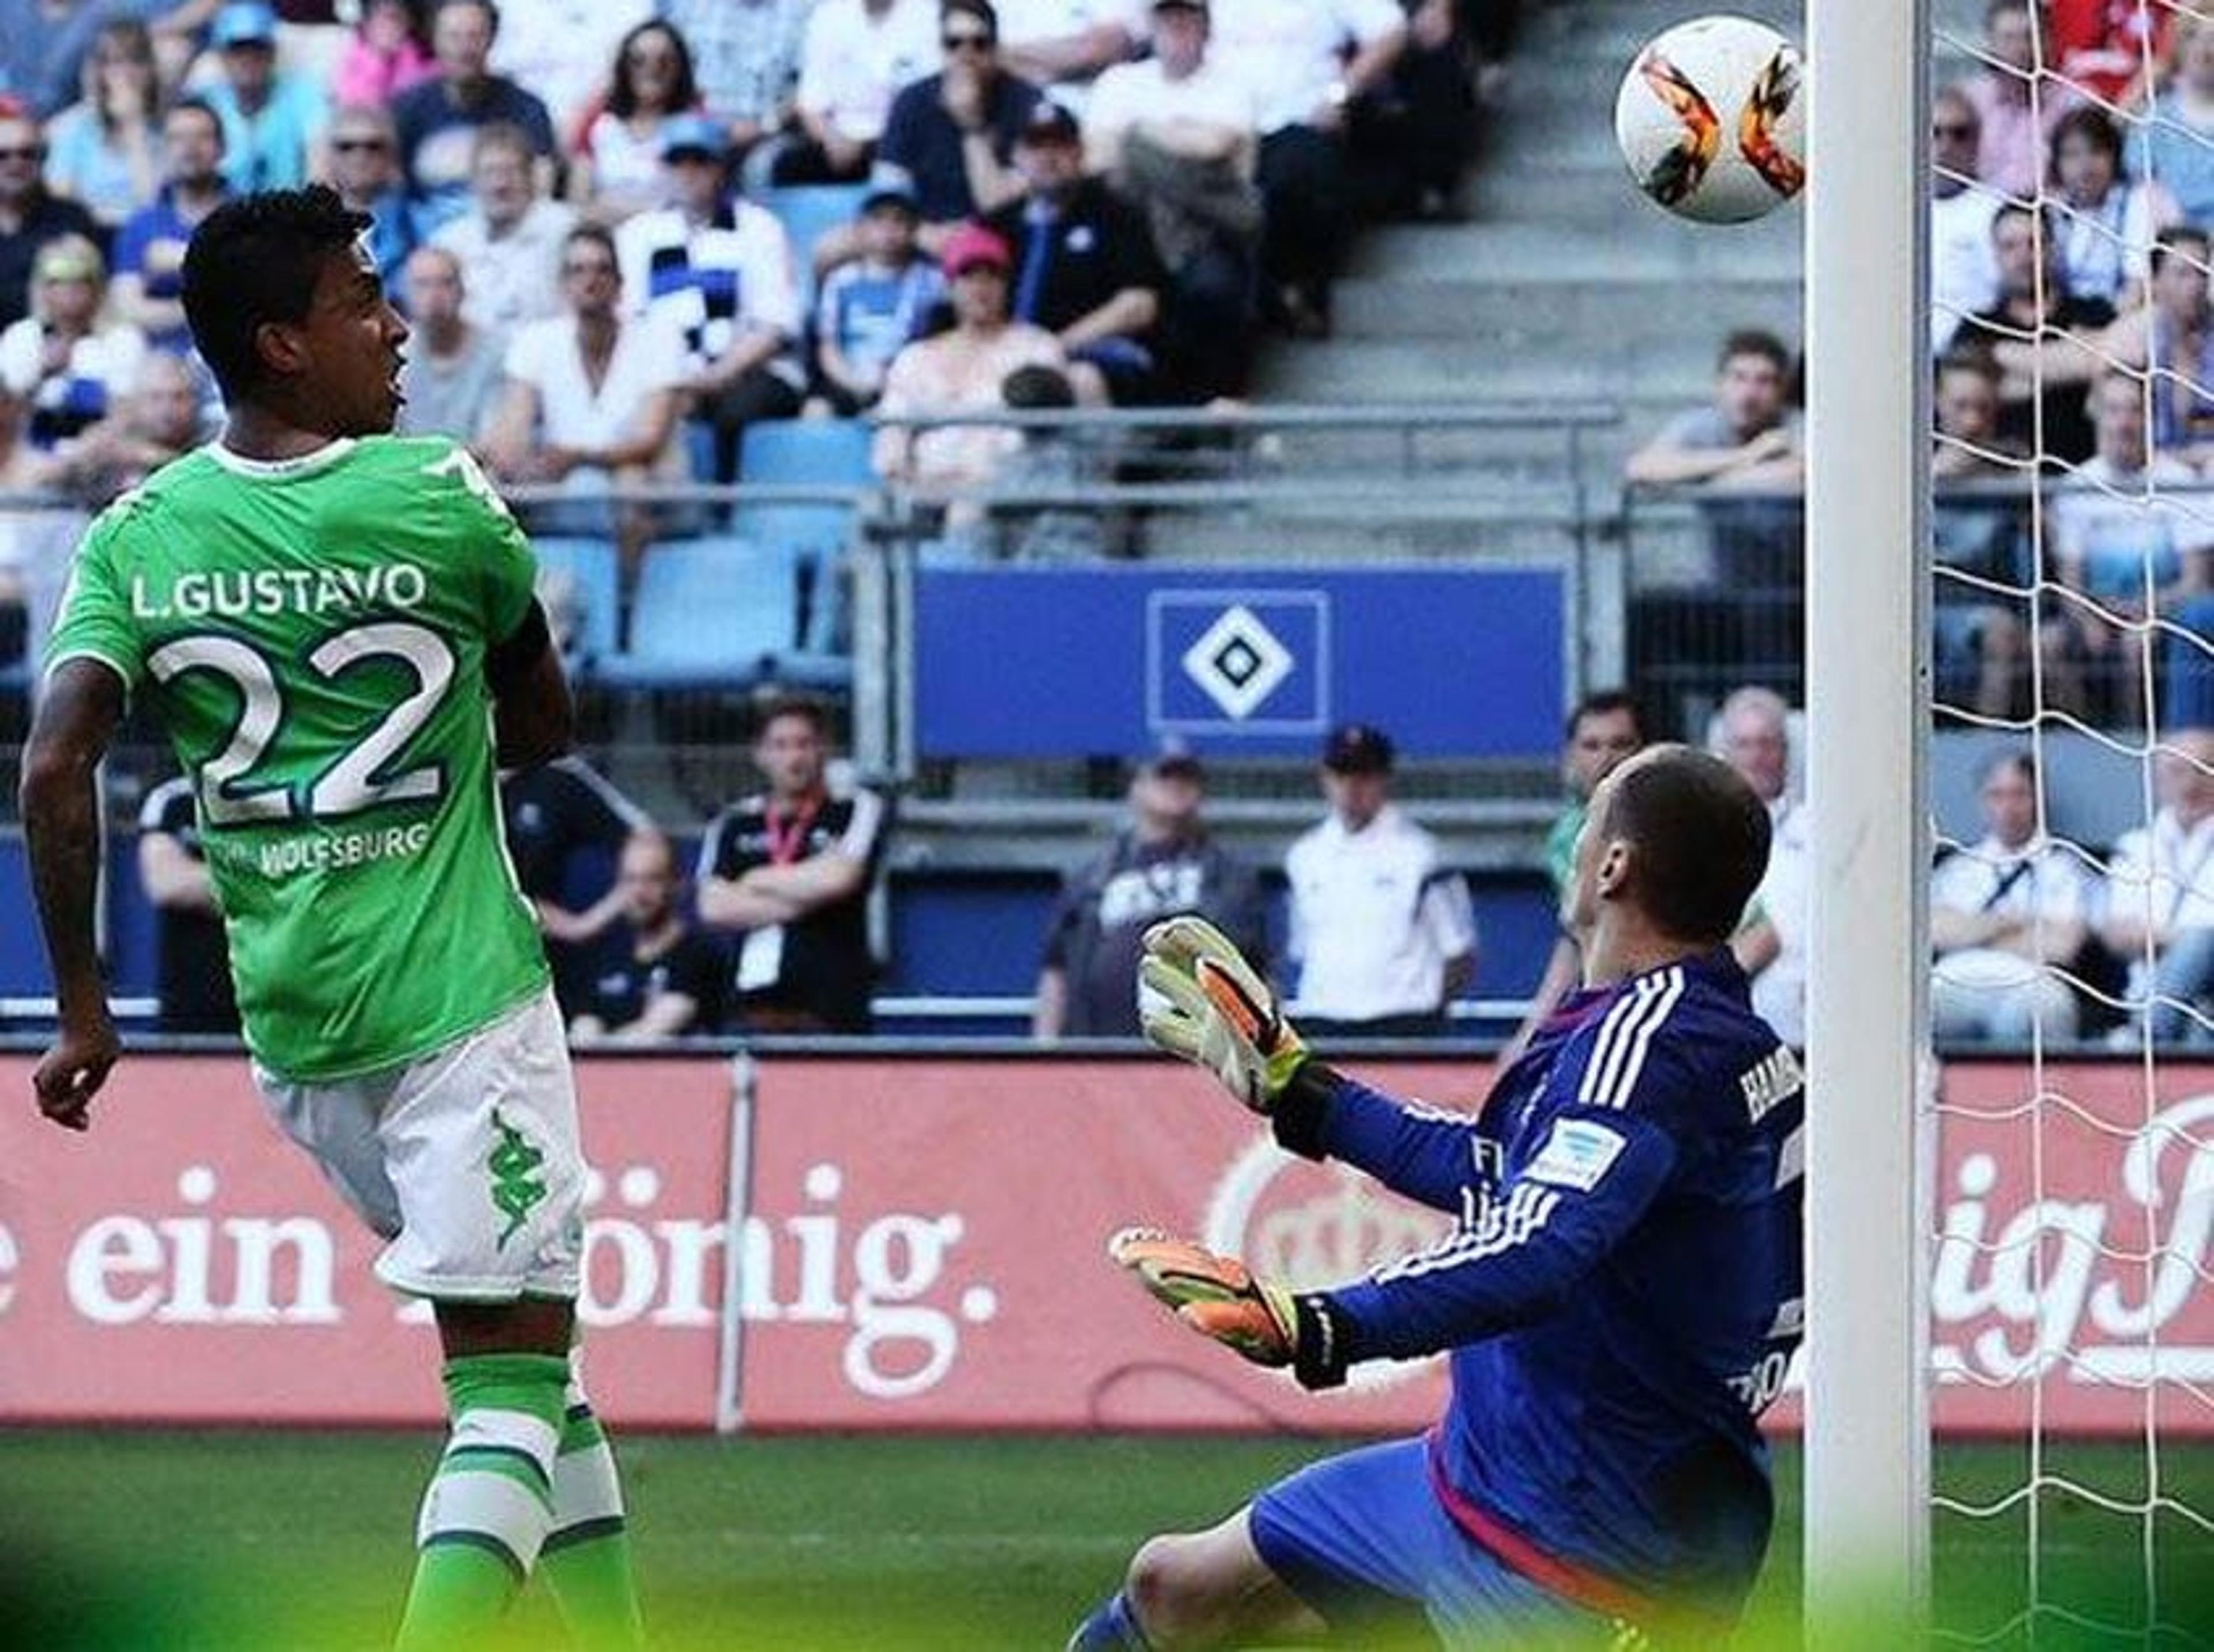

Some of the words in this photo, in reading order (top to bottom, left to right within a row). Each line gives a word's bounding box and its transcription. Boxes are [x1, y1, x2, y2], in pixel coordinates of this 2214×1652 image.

[131, 563, 426, 618] L.GUSTAVO
[146, 622, 455, 825] 22
[261, 822, 428, 880] WOLFSBURG
[66, 1166, 342, 1324] ein
[394, 1162, 997, 1398] önig.
